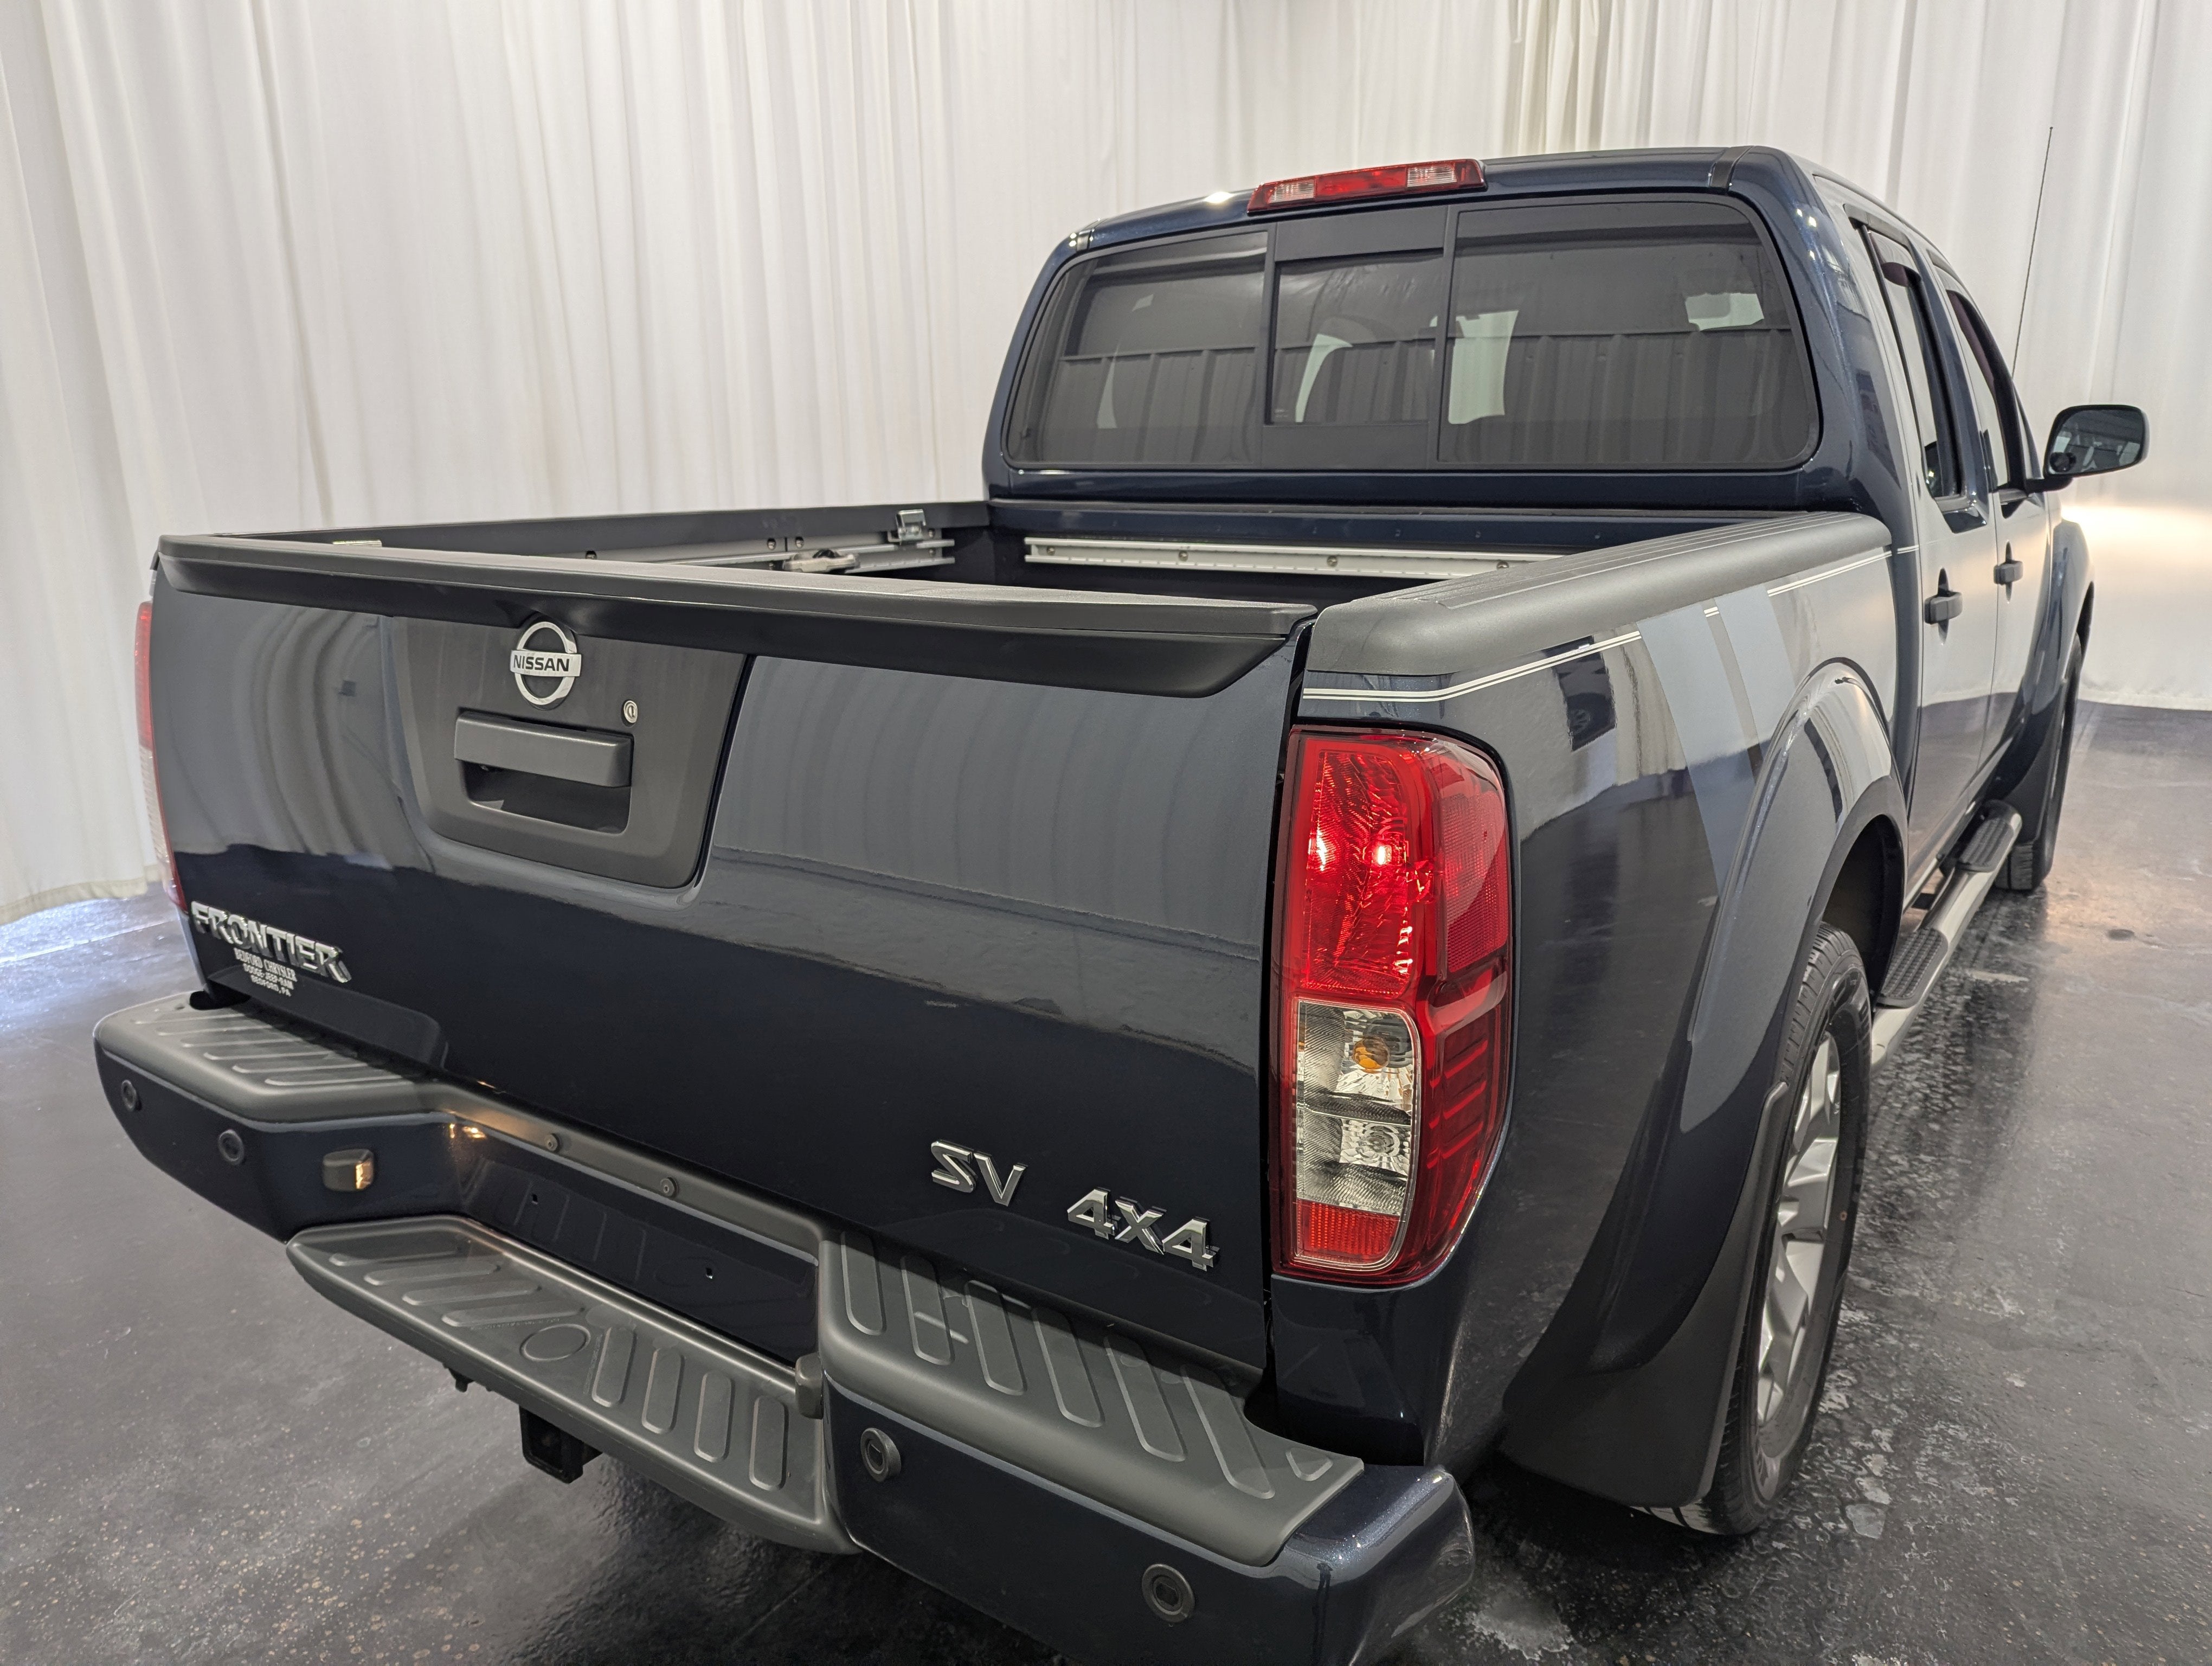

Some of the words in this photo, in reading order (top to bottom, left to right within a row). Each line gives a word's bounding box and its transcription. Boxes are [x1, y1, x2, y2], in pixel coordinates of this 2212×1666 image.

[513, 655, 570, 672] NISSAN
[191, 901, 351, 983] FRONTIER
[931, 1139, 1028, 1207] SV
[1067, 1186, 1219, 1272] 4X4
